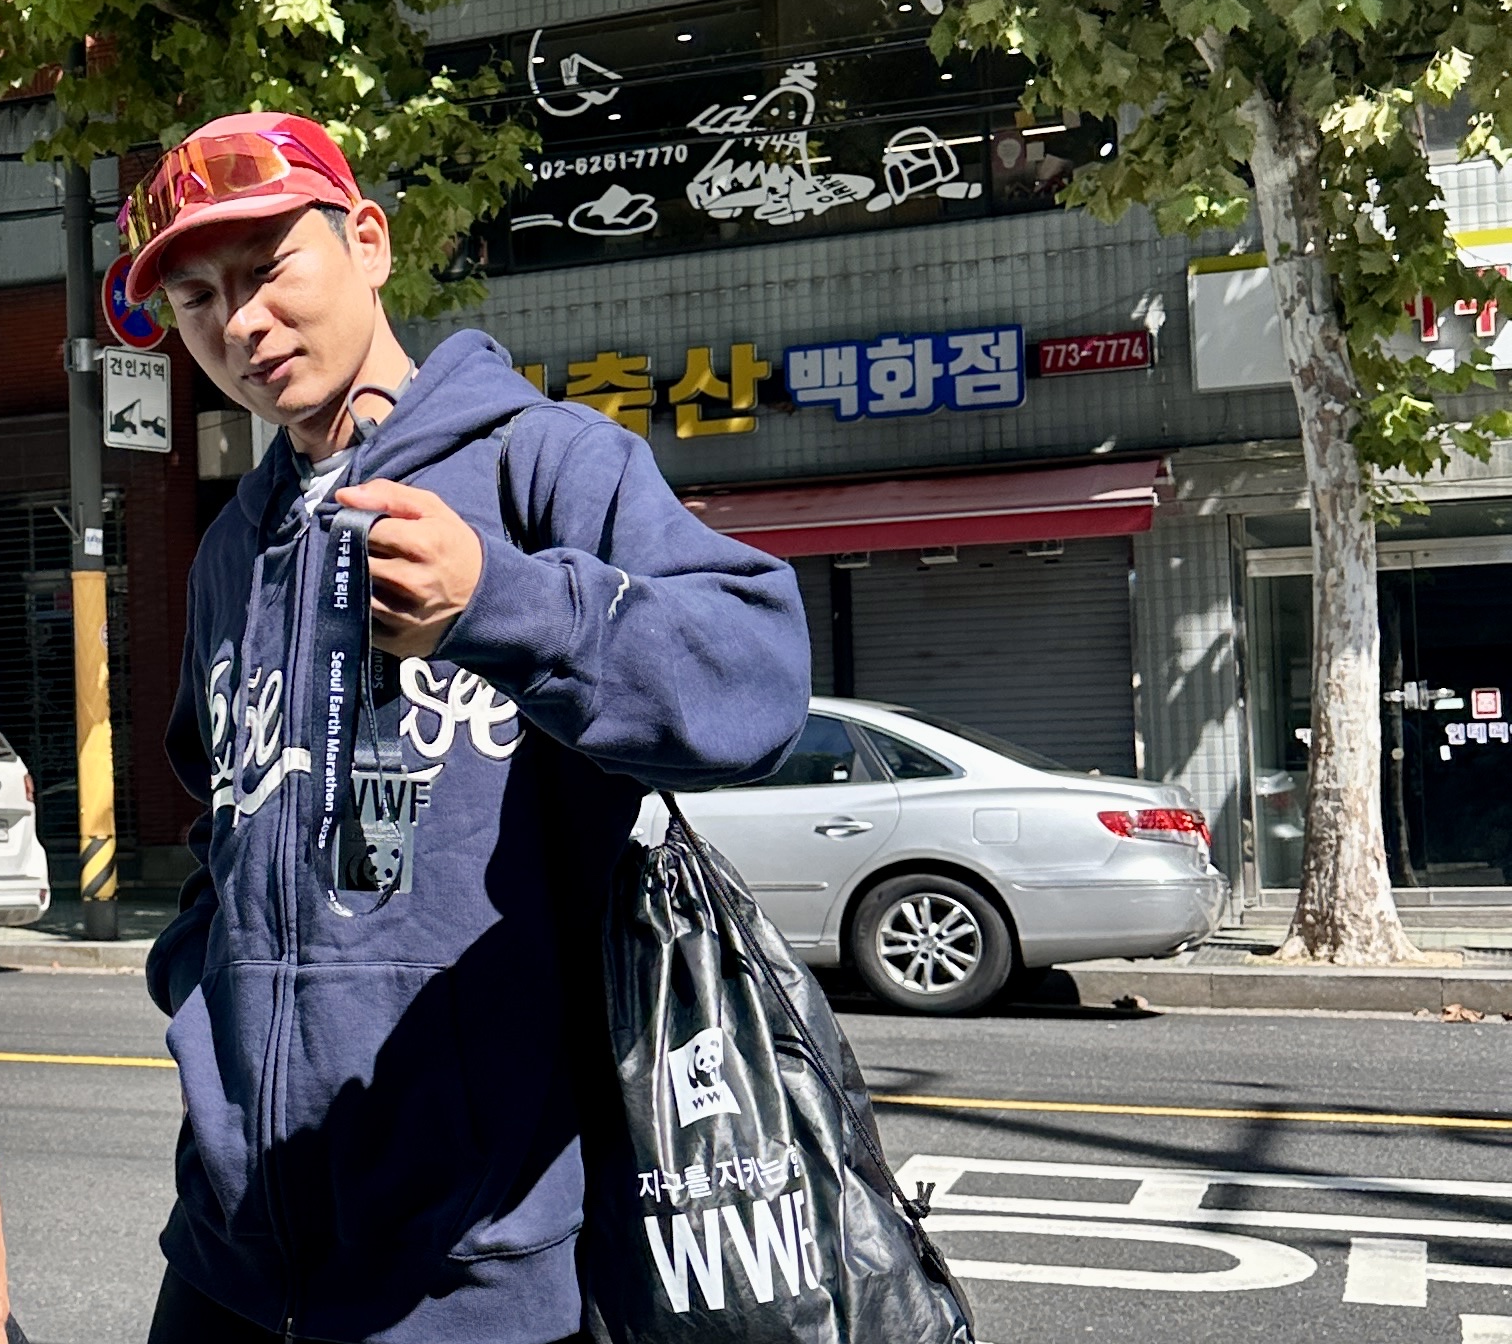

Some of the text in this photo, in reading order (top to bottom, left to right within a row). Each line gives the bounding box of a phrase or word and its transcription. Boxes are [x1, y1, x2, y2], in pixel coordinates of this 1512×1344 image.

[540, 144, 688, 180] 02-6261-7770
[110, 356, 165, 382] 견인지역
[1042, 337, 1144, 369] 773-7774
[513, 329, 1019, 439] 축산 백화점
[317, 651, 345, 850] Seoul Earth Marathon 2025
[638, 1164, 713, 1203] 지구를
[715, 1156, 789, 1191] 지키는
